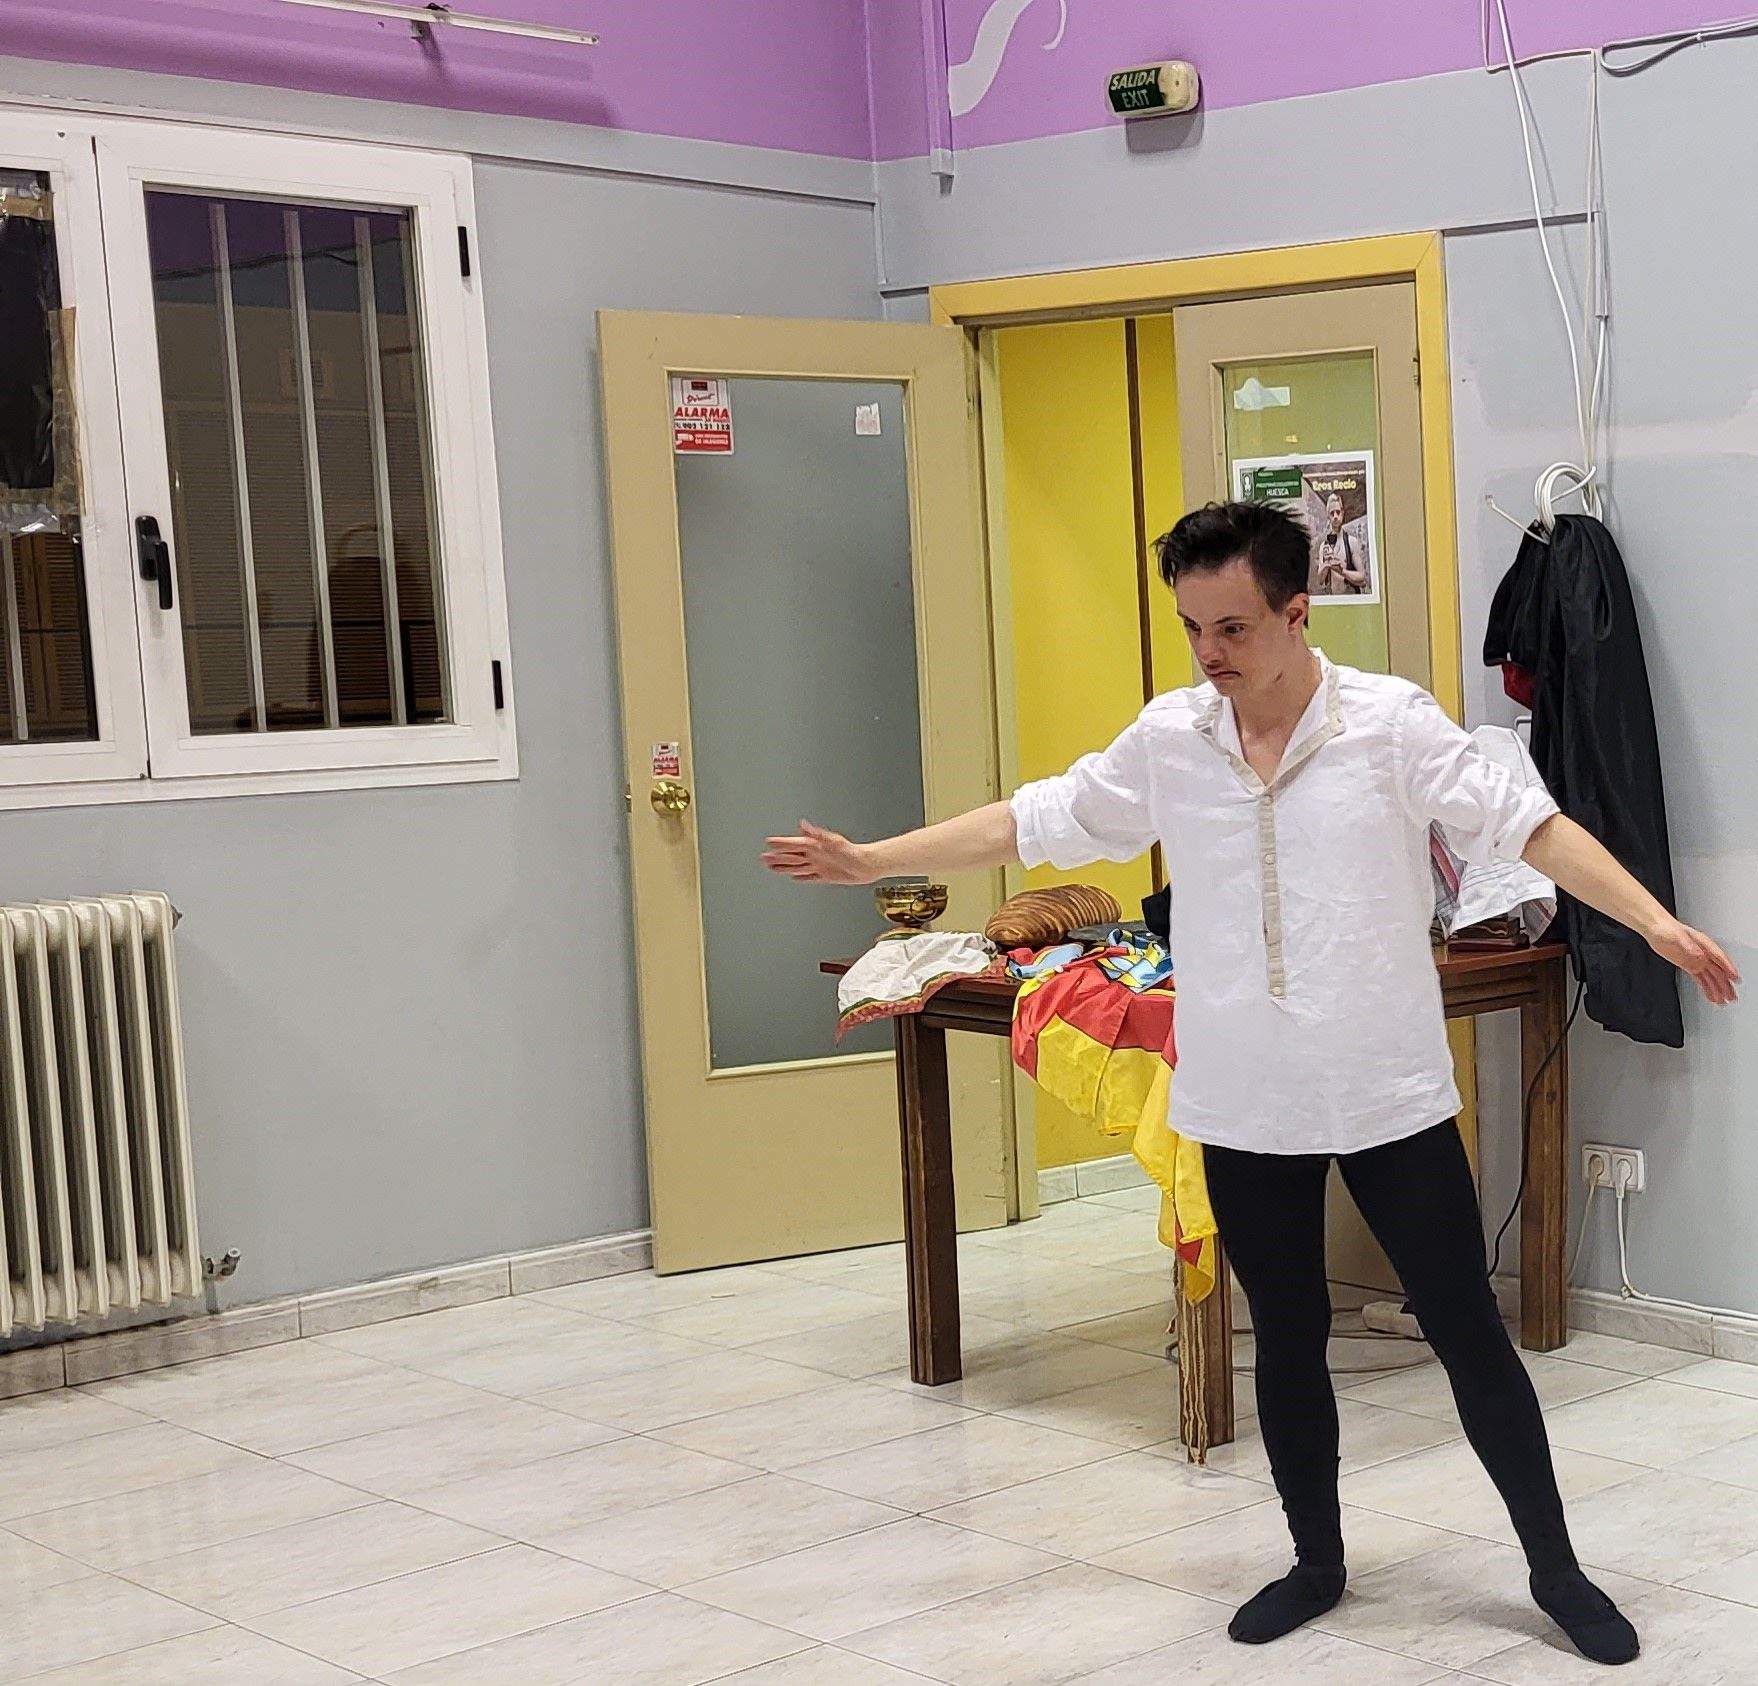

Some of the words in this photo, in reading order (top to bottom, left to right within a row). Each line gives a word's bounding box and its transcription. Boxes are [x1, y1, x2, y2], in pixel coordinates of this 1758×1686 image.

[1111, 69, 1156, 91] SALIDA
[1122, 89, 1150, 108] EXIT
[674, 407, 729, 418] ALARMA
[1266, 487, 1290, 497] HUESCA
